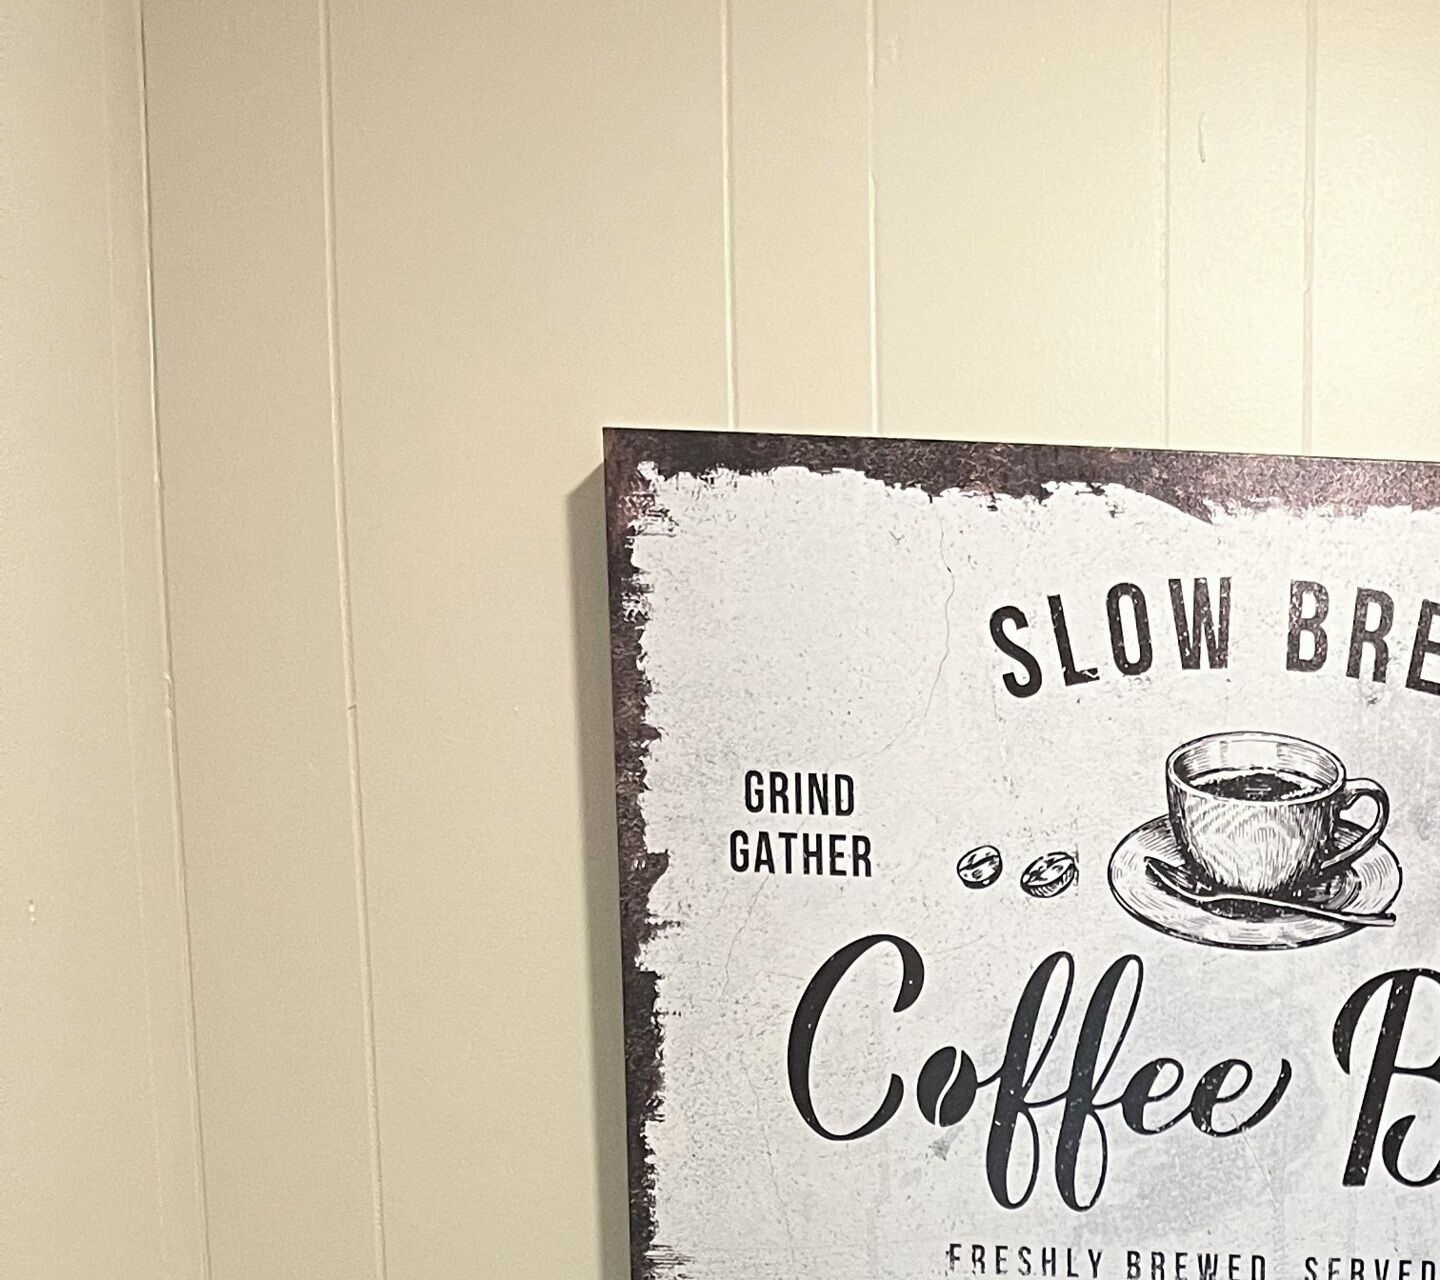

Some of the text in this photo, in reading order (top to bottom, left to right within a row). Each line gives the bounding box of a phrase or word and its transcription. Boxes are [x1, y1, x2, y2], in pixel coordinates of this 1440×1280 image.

[989, 577, 1231, 698] SLOW
[744, 769, 855, 816] GRIND
[729, 829, 872, 877] GATHER
[787, 933, 1292, 1211] Coffee
[948, 1243, 1103, 1279] FRESHLY
